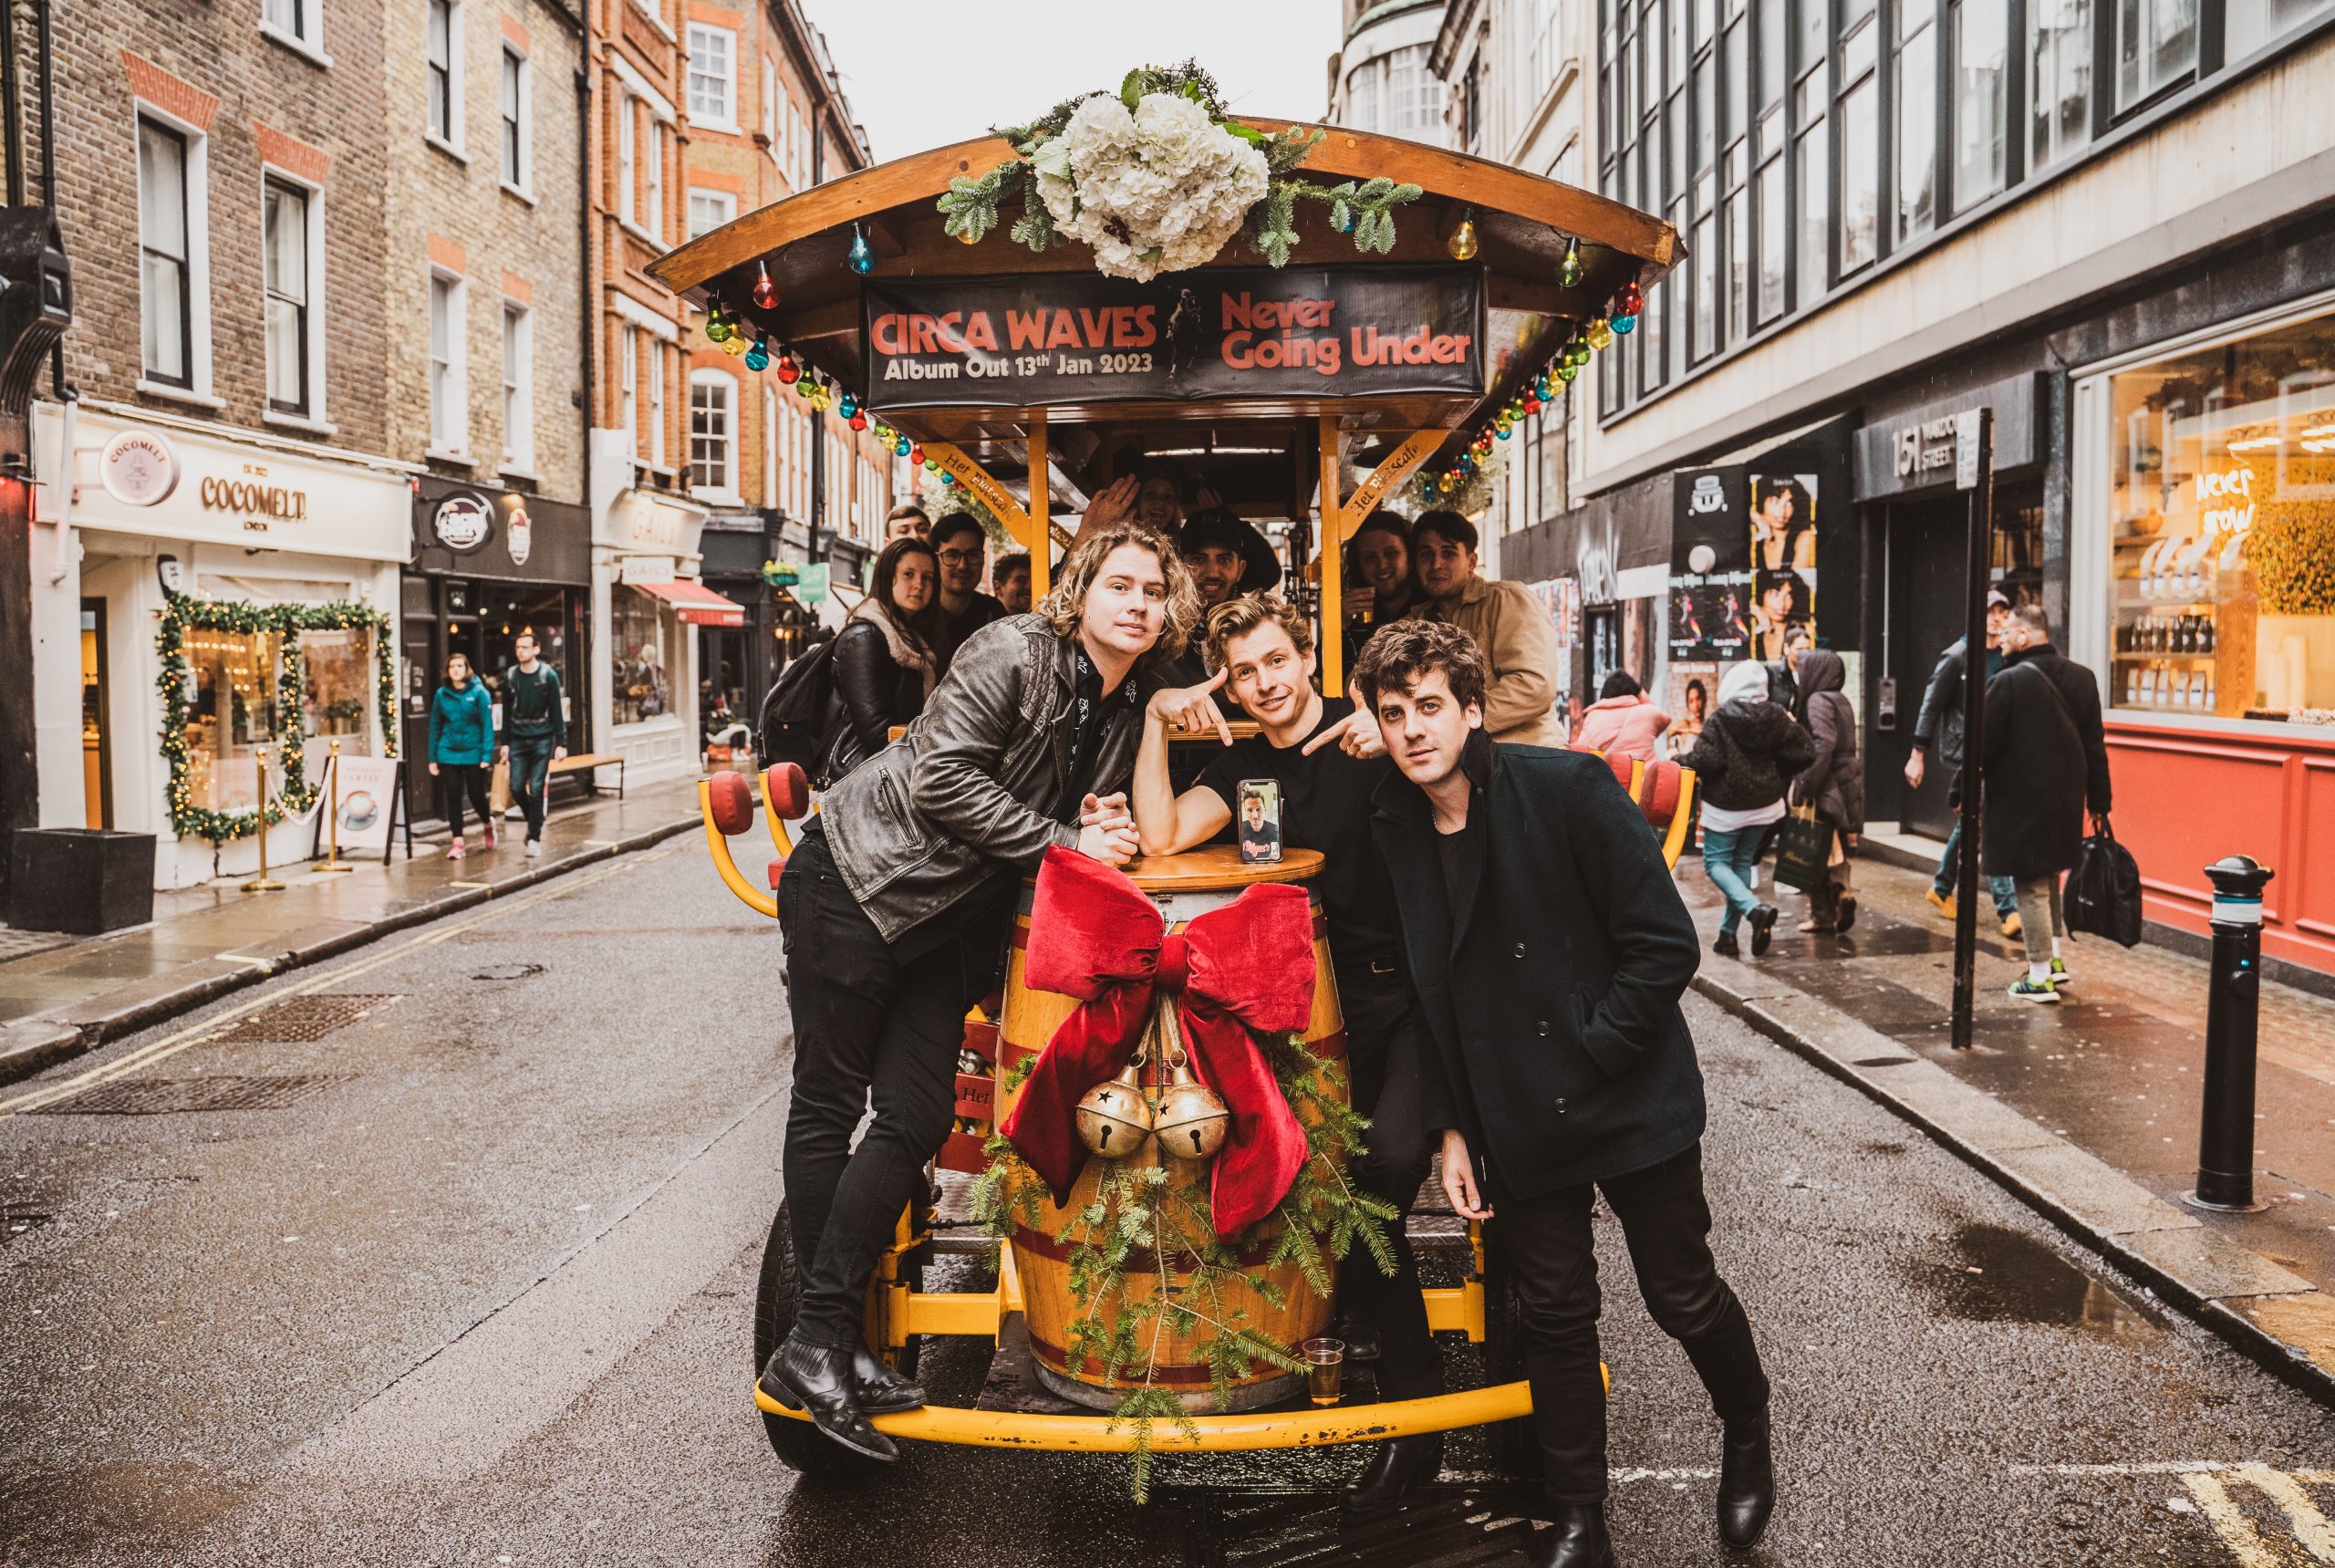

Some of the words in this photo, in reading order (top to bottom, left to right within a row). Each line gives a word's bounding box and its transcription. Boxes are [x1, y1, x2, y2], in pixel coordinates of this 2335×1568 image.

[1221, 292, 1334, 330] Never
[871, 310, 999, 355] CIRCA
[1006, 305, 1157, 350] WAVES
[1221, 329, 1341, 376] Going
[1351, 324, 1471, 366] Under
[884, 359, 959, 380] Album
[965, 357, 1009, 379] Out
[1015, 353, 1050, 377] 13th
[1056, 355, 1093, 375] Jan
[1100, 353, 1153, 374] 2023
[110, 440, 166, 463] COCOMELT
[944, 453, 970, 476] Het
[1893, 425, 1920, 477] 151
[962, 1087, 991, 1105] Het
